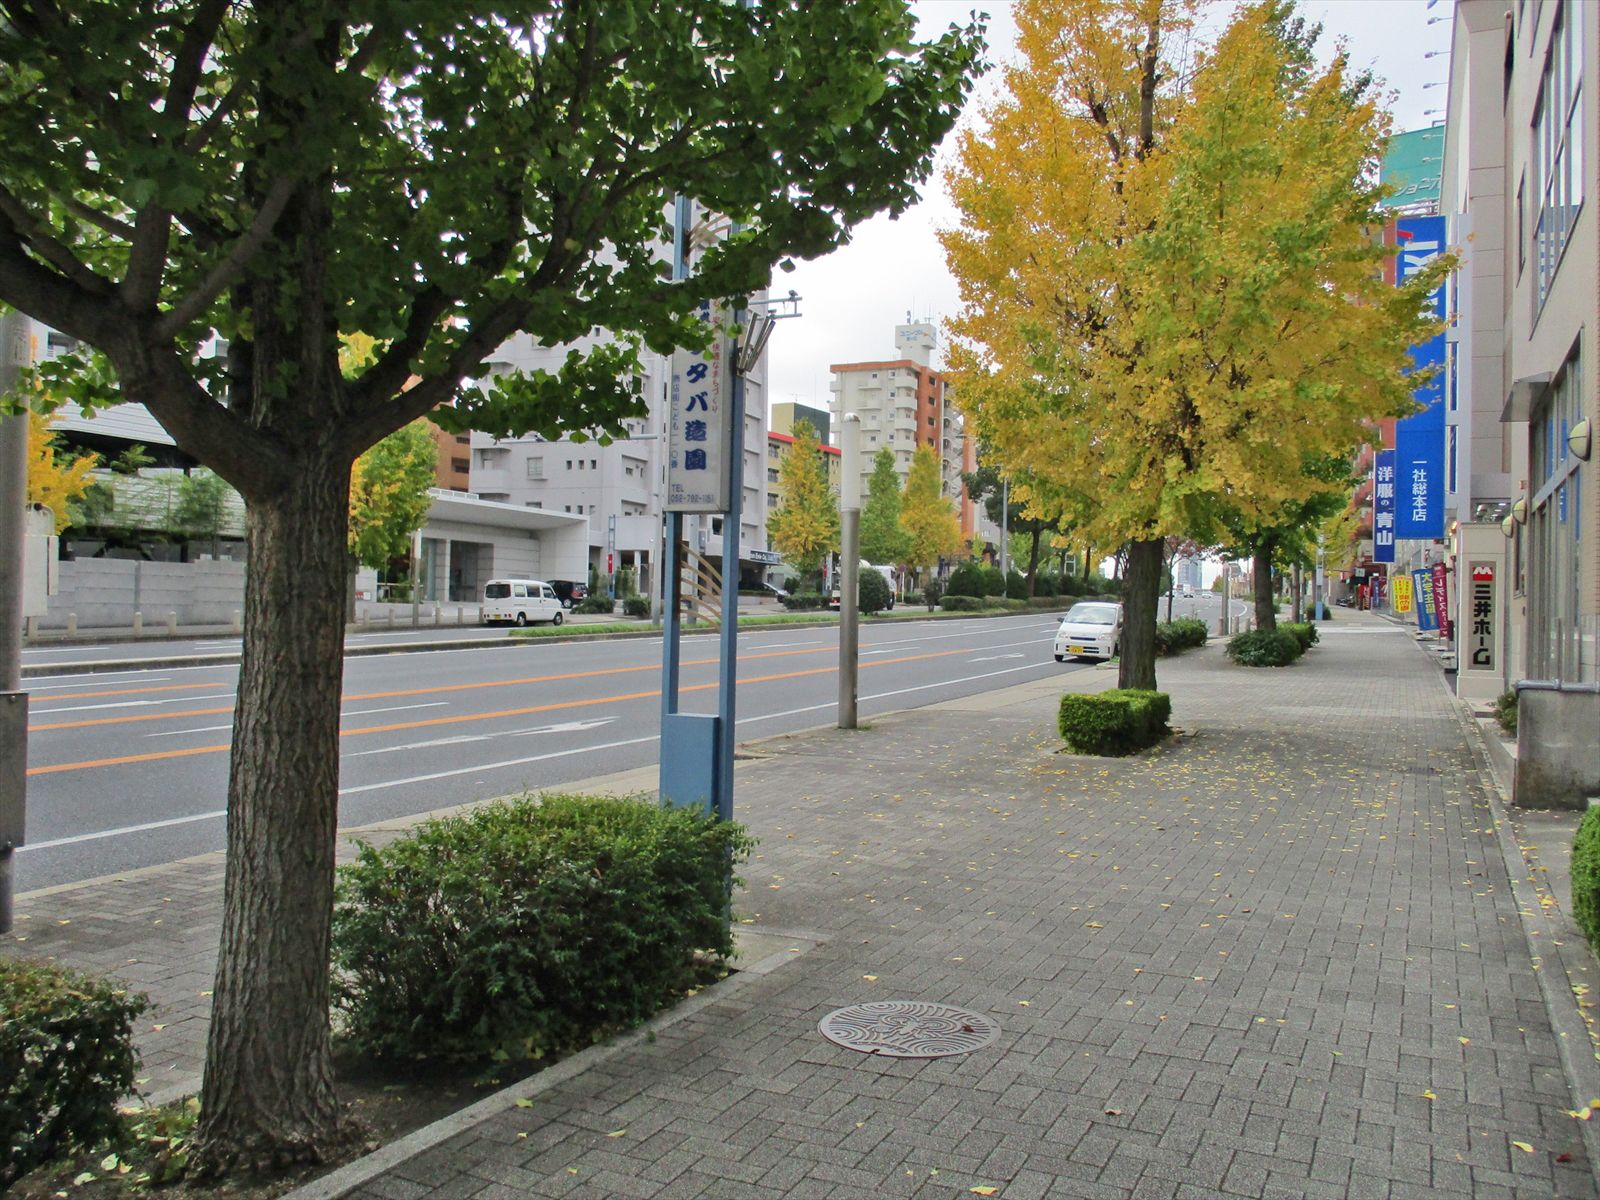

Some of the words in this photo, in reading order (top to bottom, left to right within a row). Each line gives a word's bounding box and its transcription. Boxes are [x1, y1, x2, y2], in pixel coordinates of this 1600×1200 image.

[684, 350, 709, 471] タバ造園
[671, 484, 684, 493] TEL
[1375, 466, 1394, 546] 洋服の青山
[1412, 461, 1428, 522] 一社総本店
[1473, 584, 1491, 665] 三井ホーム
